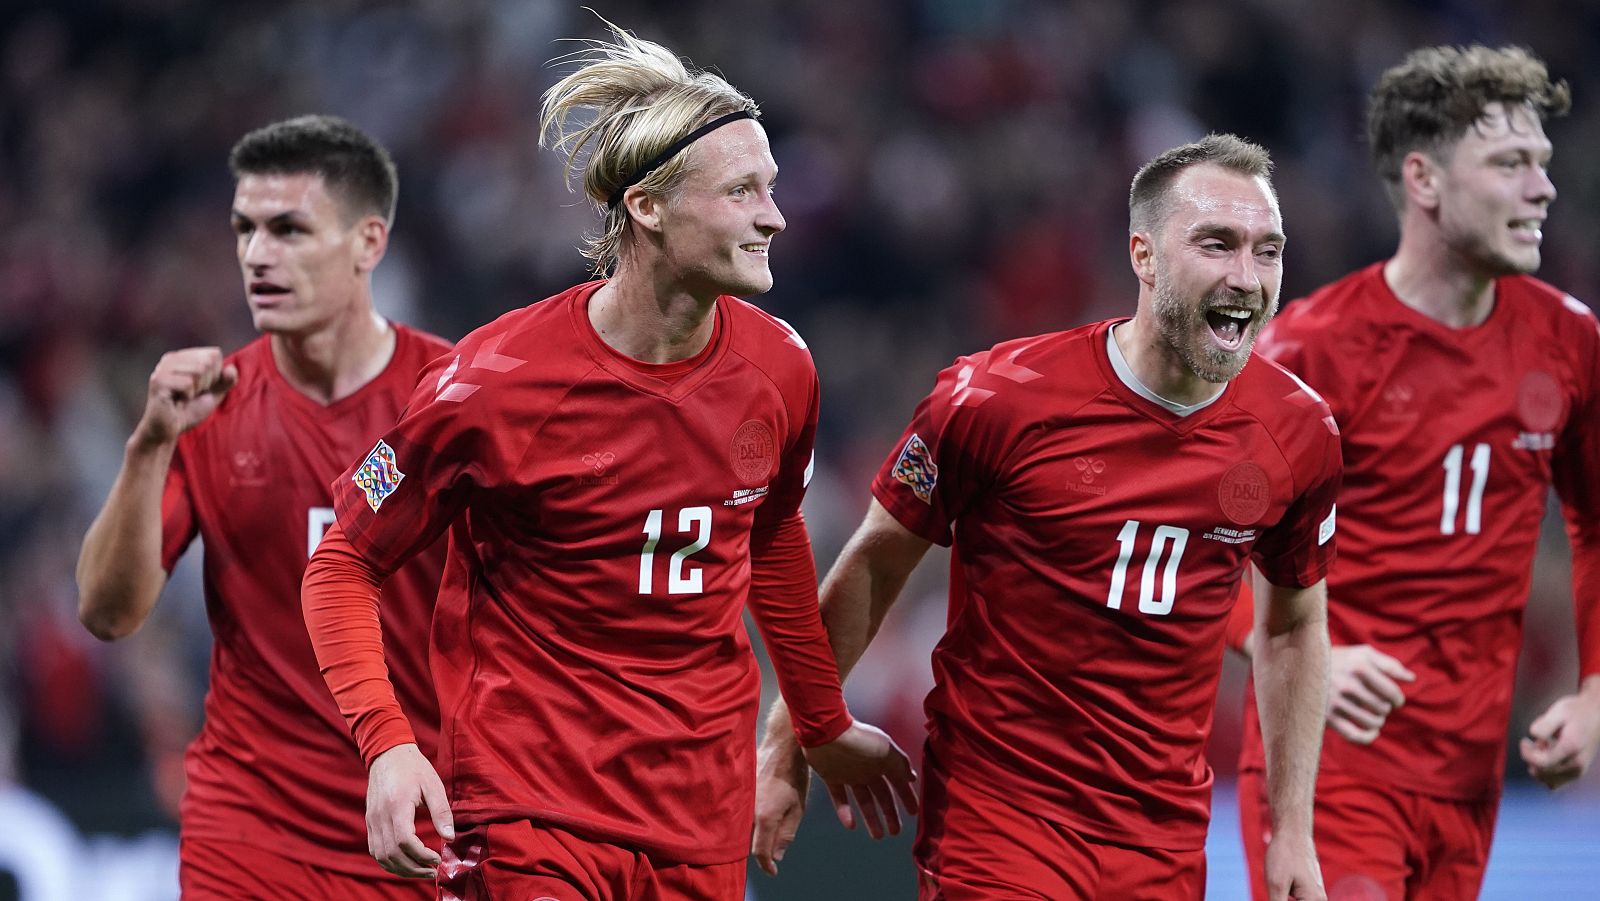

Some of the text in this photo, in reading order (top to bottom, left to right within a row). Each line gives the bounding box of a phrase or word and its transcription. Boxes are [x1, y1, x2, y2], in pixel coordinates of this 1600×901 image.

[1065, 480, 1106, 496] hummel
[1213, 526, 1239, 537] DENMARK
[1440, 443, 1491, 535] 11
[638, 506, 712, 595] 12
[1106, 520, 1190, 615] 10
